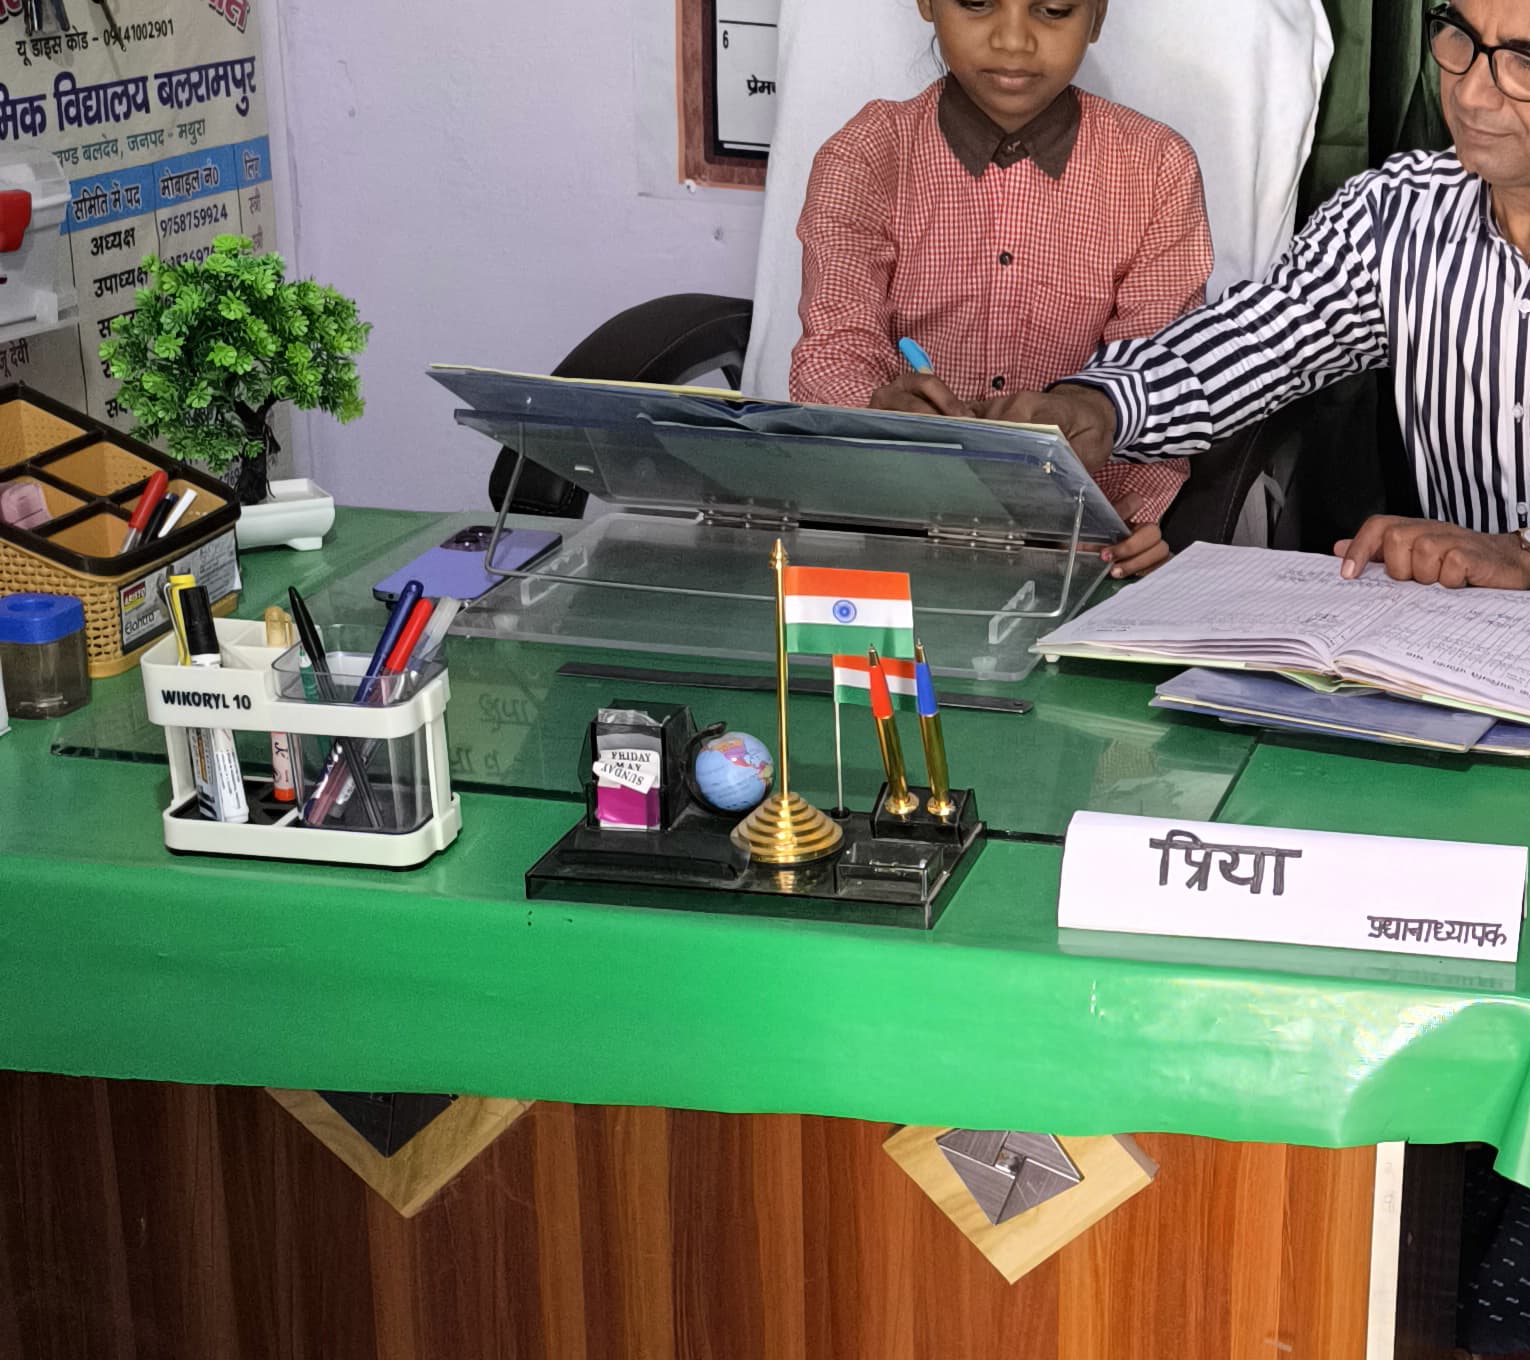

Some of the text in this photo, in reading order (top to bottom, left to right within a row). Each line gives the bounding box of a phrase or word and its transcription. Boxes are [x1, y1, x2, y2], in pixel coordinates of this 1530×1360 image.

[53, 56, 257, 132] विद्यालय बलरामपुर
[127, 129, 165, 153] जनपद
[73, 168, 200, 222] समिति में पद मोबाइल
[90, 204, 228, 257] अध्यक्ष 9758759924
[161, 688, 252, 711] WIKORYL 10
[1149, 828, 1303, 897] प्रिया
[1366, 914, 1508, 949] प्रधानाध्यापक
